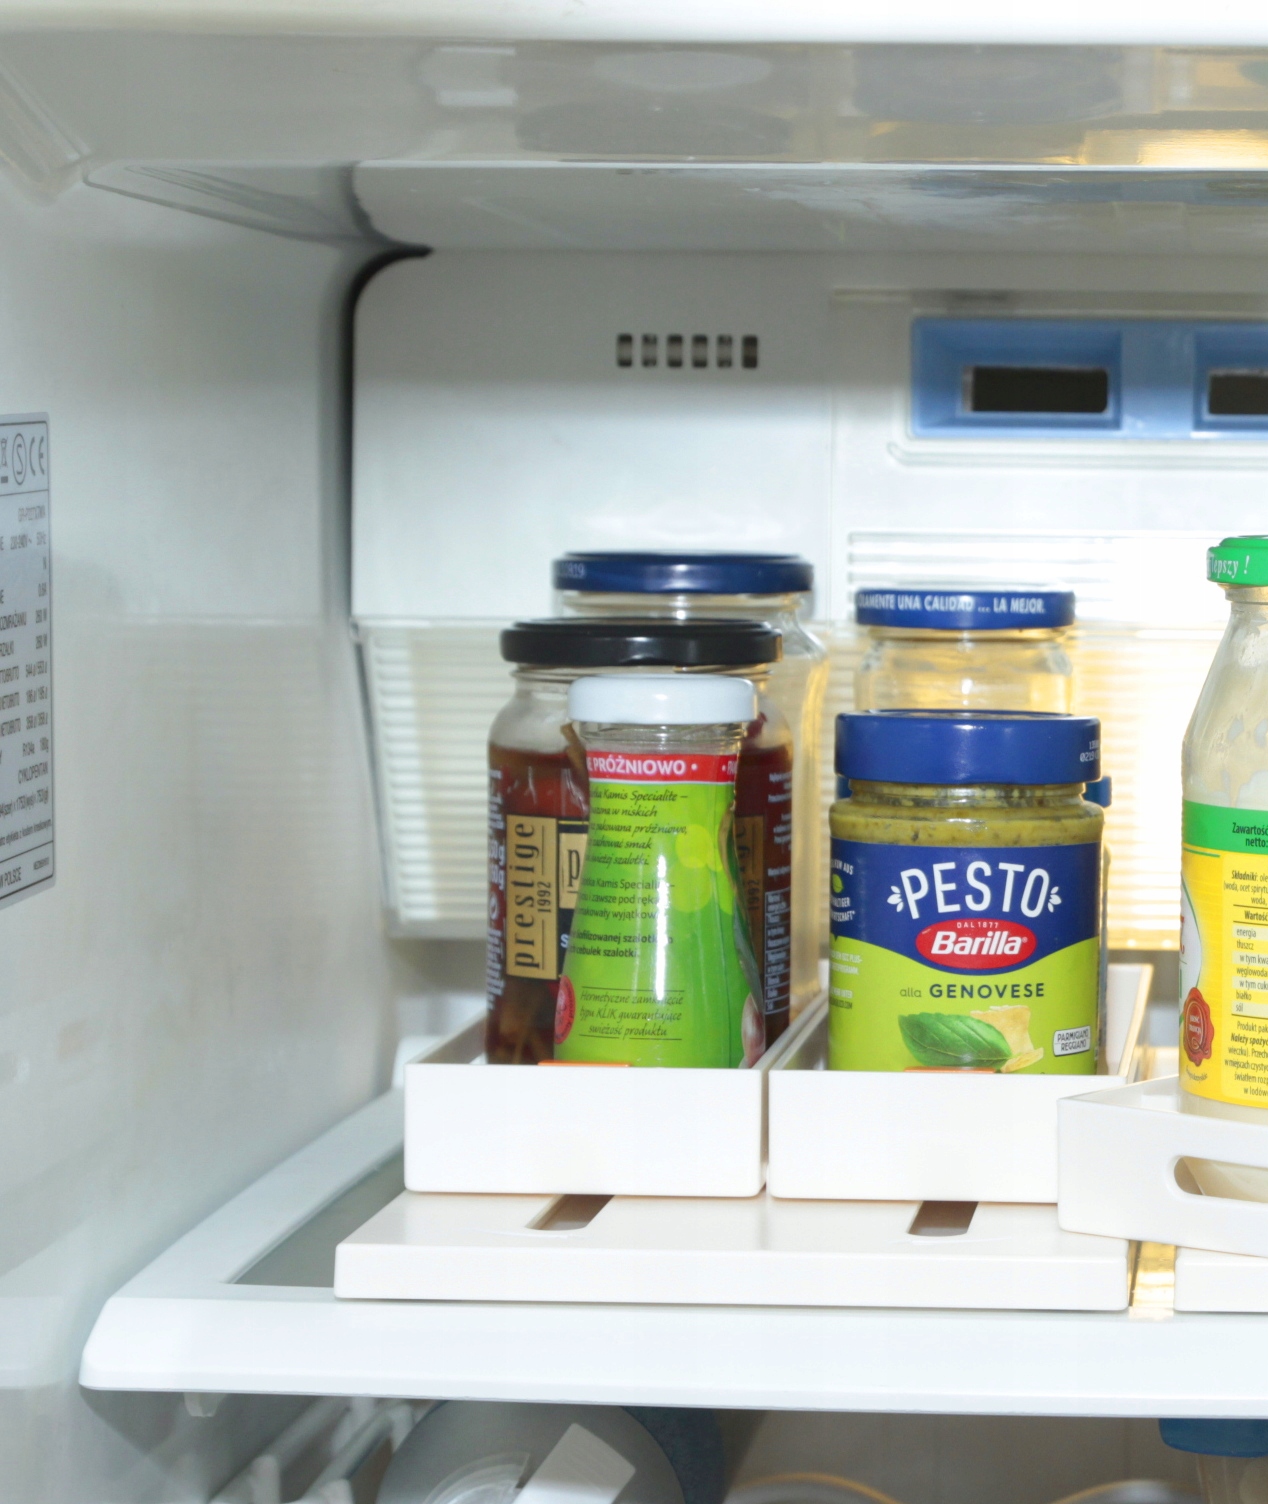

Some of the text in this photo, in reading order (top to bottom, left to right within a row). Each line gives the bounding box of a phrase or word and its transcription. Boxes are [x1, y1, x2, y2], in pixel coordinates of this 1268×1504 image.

[897, 595, 1046, 614] UNA CALIDAD LA MEJOR.
[593, 754, 686, 775] PRÓŻNIOWO
[602, 788, 628, 801] Kamis
[630, 789, 678, 807] Specialite
[621, 804, 658, 818] niskich
[631, 823, 688, 838] próżniowo,
[1232, 822, 1268, 837] Zawartość
[624, 838, 652, 850] smak
[1245, 837, 1268, 849] netto:
[508, 823, 540, 969] prestige
[536, 881, 552, 914] 1992
[900, 860, 1051, 920] PESTO
[618, 895, 635, 906] pod
[1251, 897, 1268, 906] woda,
[1244, 911, 1268, 922] Wartość
[956, 921, 999, 930] DAL 1877
[1236, 928, 1257, 939] energia
[930, 931, 1022, 956] Barilla
[1245, 955, 1257, 965] tym
[899, 982, 1046, 1000] alla GENOVESE
[1245, 981, 1257, 990] tym
[580, 988, 630, 1008] Hermetyczne
[595, 1008, 617, 1020] KLIK
[1235, 1003, 1243, 1012] sól
[1236, 1021, 1258, 1033] Produkt
[1057, 1027, 1090, 1045] PARMIGIANO
[1060, 1038, 1088, 1053] REGGIANO
